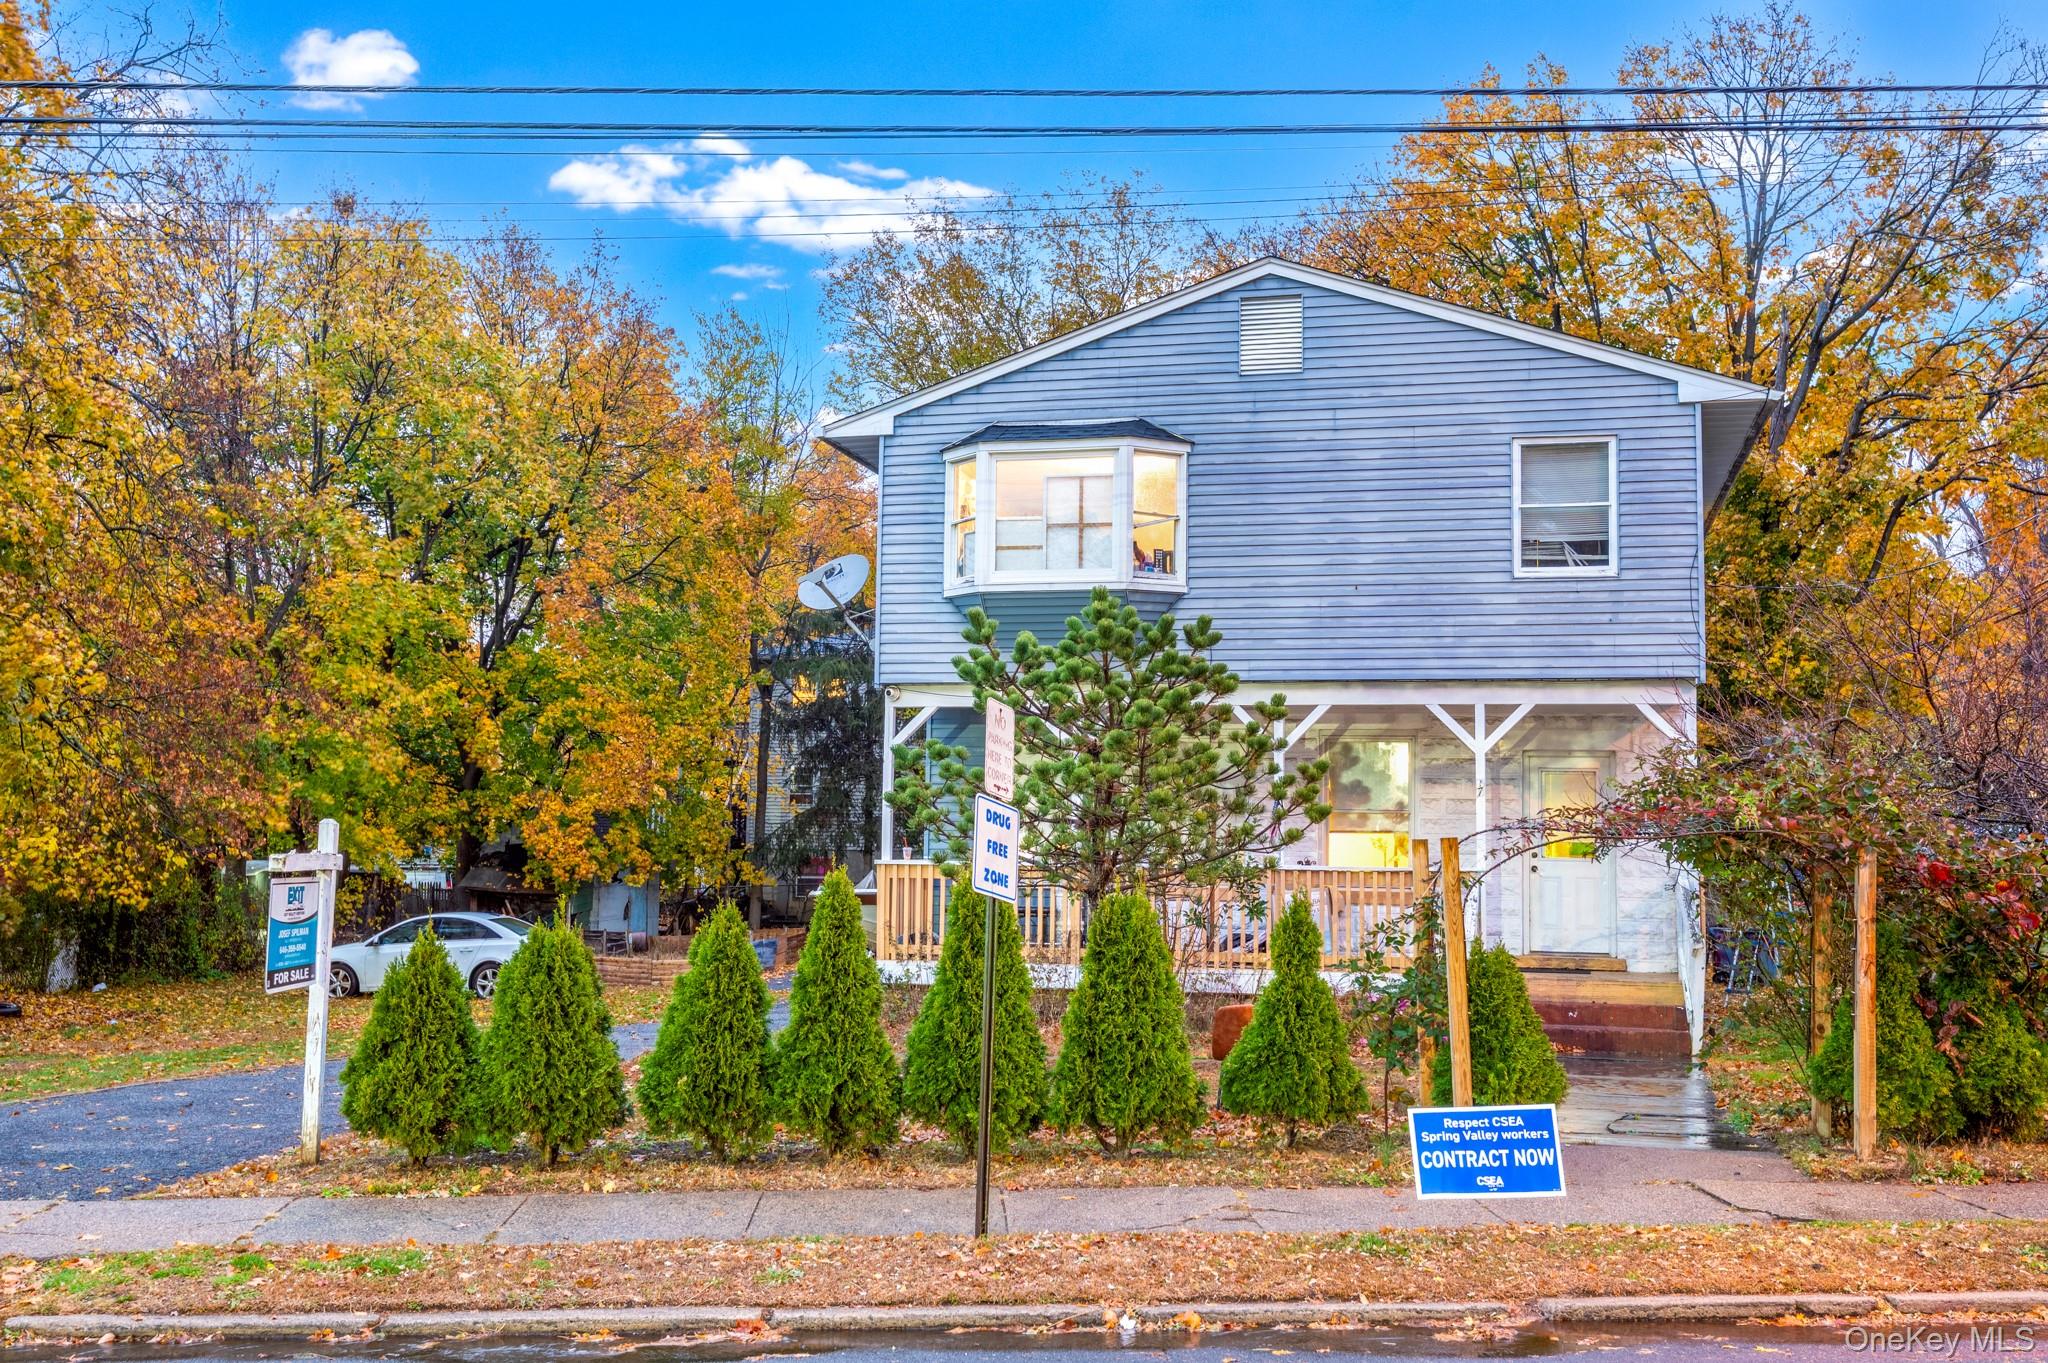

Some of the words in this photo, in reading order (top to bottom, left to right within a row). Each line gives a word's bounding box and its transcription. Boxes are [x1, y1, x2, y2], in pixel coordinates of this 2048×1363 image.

[986, 808, 1011, 830] DRUG
[987, 838, 1009, 859] FREE
[983, 867, 1009, 889] ZONE
[273, 972, 289, 985] FOR
[290, 968, 309, 981] SALE
[1443, 1117, 1490, 1129] Respect
[1492, 1116, 1524, 1127] CSEA
[1421, 1131, 1460, 1144] Spring
[1463, 1130, 1498, 1142] Valley
[1501, 1129, 1549, 1139] workers
[1420, 1149, 1509, 1169] CONTRACT
[1514, 1148, 1554, 1167] NOW
[1476, 1176, 1504, 1186] CSEA
